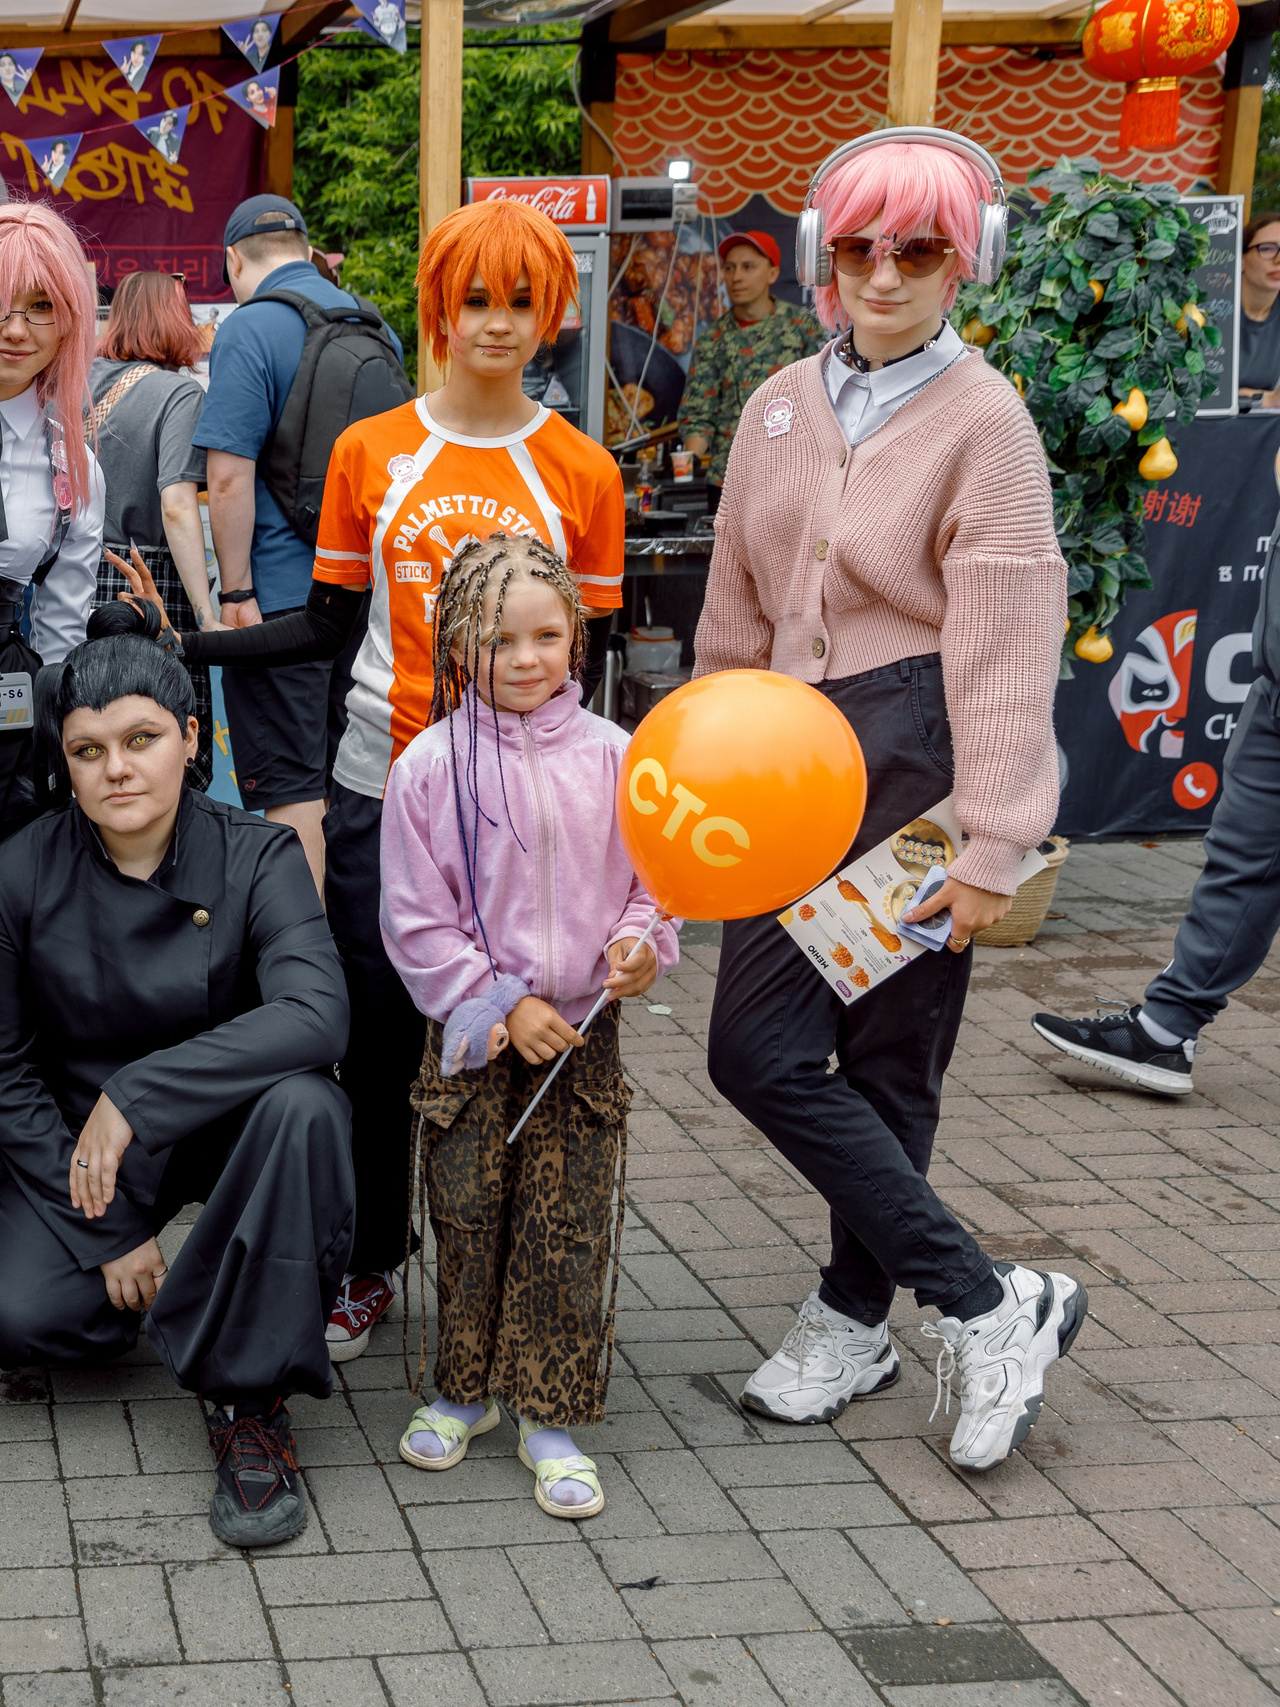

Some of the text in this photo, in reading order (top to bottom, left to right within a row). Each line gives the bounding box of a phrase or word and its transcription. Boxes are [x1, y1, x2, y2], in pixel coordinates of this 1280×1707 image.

[393, 495, 542, 553] PALMETTO STA
[396, 564, 430, 579] STICK
[807, 943, 829, 970] МЕНЮ
